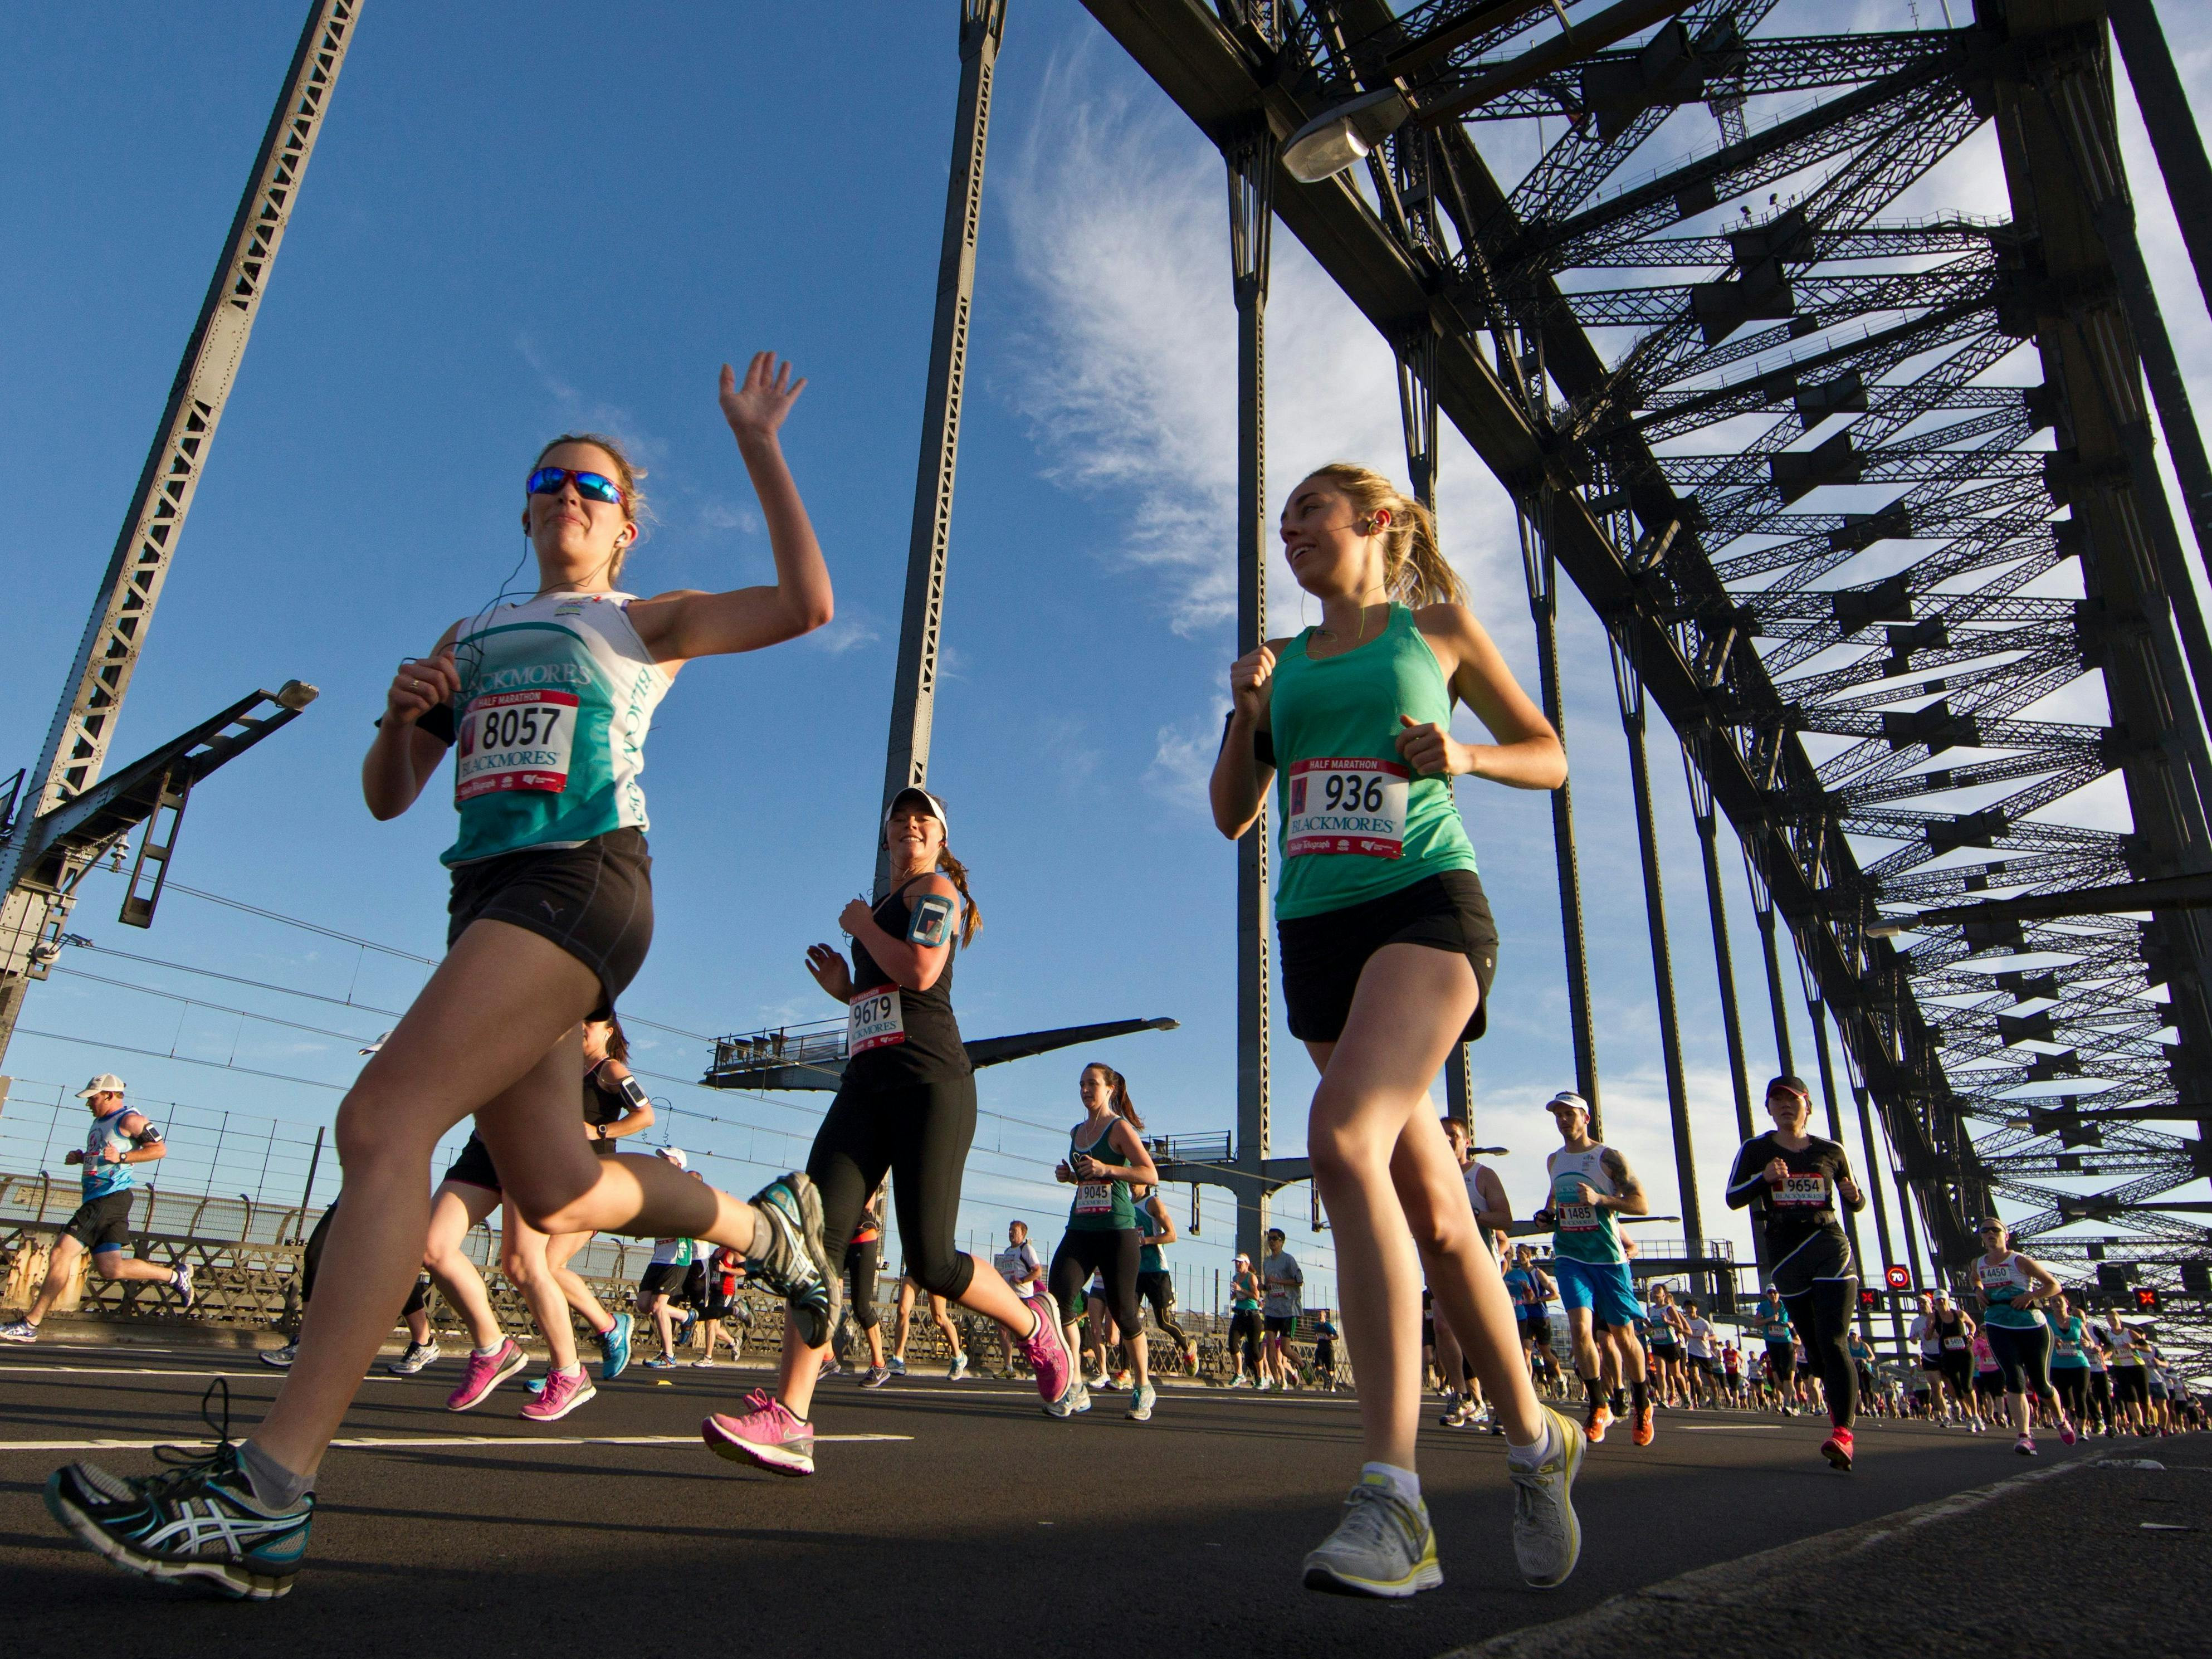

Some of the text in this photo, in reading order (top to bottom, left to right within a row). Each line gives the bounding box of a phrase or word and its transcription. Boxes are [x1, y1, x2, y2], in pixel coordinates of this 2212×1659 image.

[478, 692, 541, 707] HALF MARATHON
[483, 707, 560, 750] 8057
[462, 751, 556, 778] BLACKMORES
[1310, 760, 1378, 769] HALF MARATHON
[1326, 774, 1383, 812] 936
[1292, 817, 1393, 834] BLACKMORES
[854, 996, 891, 1028] 9679
[1085, 1185, 1107, 1198] 9045
[1788, 1179, 1819, 1192] 9654
[1568, 1207, 1591, 1219] 1485
[1891, 1272, 1903, 1282] 70
[1987, 1267, 2006, 1277] 4450
